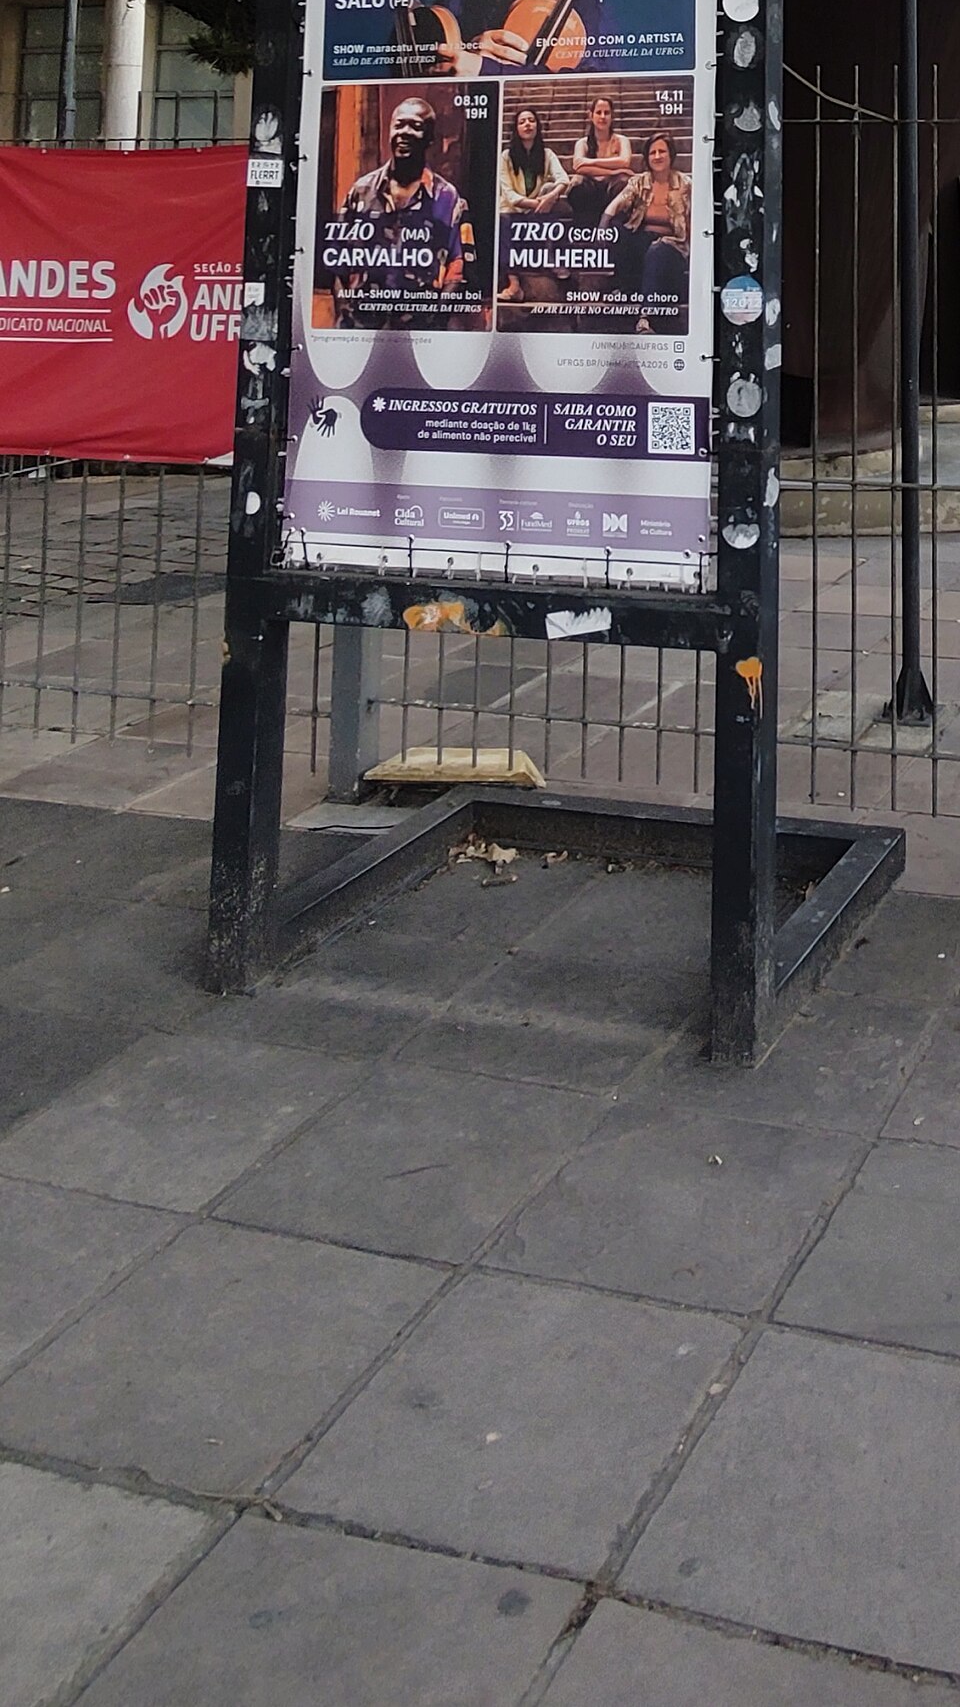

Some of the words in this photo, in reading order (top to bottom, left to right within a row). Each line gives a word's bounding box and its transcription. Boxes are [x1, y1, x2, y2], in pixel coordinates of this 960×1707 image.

[536, 36, 596, 47] ENCONTRO
[598, 35, 624, 45] COM
[627, 34, 636, 44] O
[638, 33, 684, 44] ARTISTA
[333, 44, 364, 54] SHOW
[366, 43, 412, 53] maracatu
[415, 42, 438, 52] rural
[555, 49, 591, 59] CENTRO
[592, 48, 638, 57] CULTURAL
[641, 48, 653, 56] DA
[655, 46, 684, 56] UFRGS
[332, 56, 359, 66] SALÃO
[360, 56, 372, 65] DE
[372, 56, 394, 65] ATOS
[396, 56, 407, 64] DA
[409, 55, 436, 64] UFRGS
[454, 94, 488, 107] 08.10
[655, 90, 683, 102] 14.11
[465, 107, 487, 119] 19H
[659, 103, 683, 115] 19H
[324, 219, 375, 241] TIÃO
[401, 227, 431, 242] (MA)
[510, 222, 565, 242] TRIO
[568, 226, 619, 243] (SC/RS)
[323, 248, 434, 268] CARVALHO
[509, 248, 615, 269] MULHERIL
[193, 262, 232, 275] SEÇÃO
[0, 260, 116, 299] NDES
[337, 289, 402, 299] AULA-SHOW
[403, 290, 438, 299] bumba
[441, 291, 462, 300] meu
[465, 290, 482, 300] boi
[566, 291, 600, 302] SHOW
[603, 292, 628, 302] roda
[630, 292, 644, 302] de
[647, 292, 679, 303] choro
[358, 303, 393, 311] CENTRO
[394, 303, 438, 312] CULTURAL
[440, 304, 452, 312] DA
[453, 304, 482, 313] UFRGS
[531, 306, 544, 314] AO
[545, 306, 558, 314] AR
[559, 306, 586, 314] LIVRE
[588, 306, 601, 315] NO
[603, 306, 639, 315] CAMPUS
[640, 306, 679, 316] CENTRO
[47, 317, 112, 332] NACIONAL
[388, 399, 459, 413] INGRESSOS
[461, 401, 538, 416] GRATUITOS
[553, 403, 593, 416] SAIBA
[596, 404, 637, 417] COMO
[425, 418, 469, 429] mediante
[470, 420, 505, 432] doação
[507, 421, 520, 431] de
[522, 422, 537, 433] 1kg
[565, 418, 636, 431] GARANTIR
[417, 429, 429, 439] de
[431, 430, 472, 441] alimento
[474, 432, 491, 442] não
[493, 432, 537, 444] perecível
[596, 434, 607, 445] O
[609, 434, 637, 447] SEU
